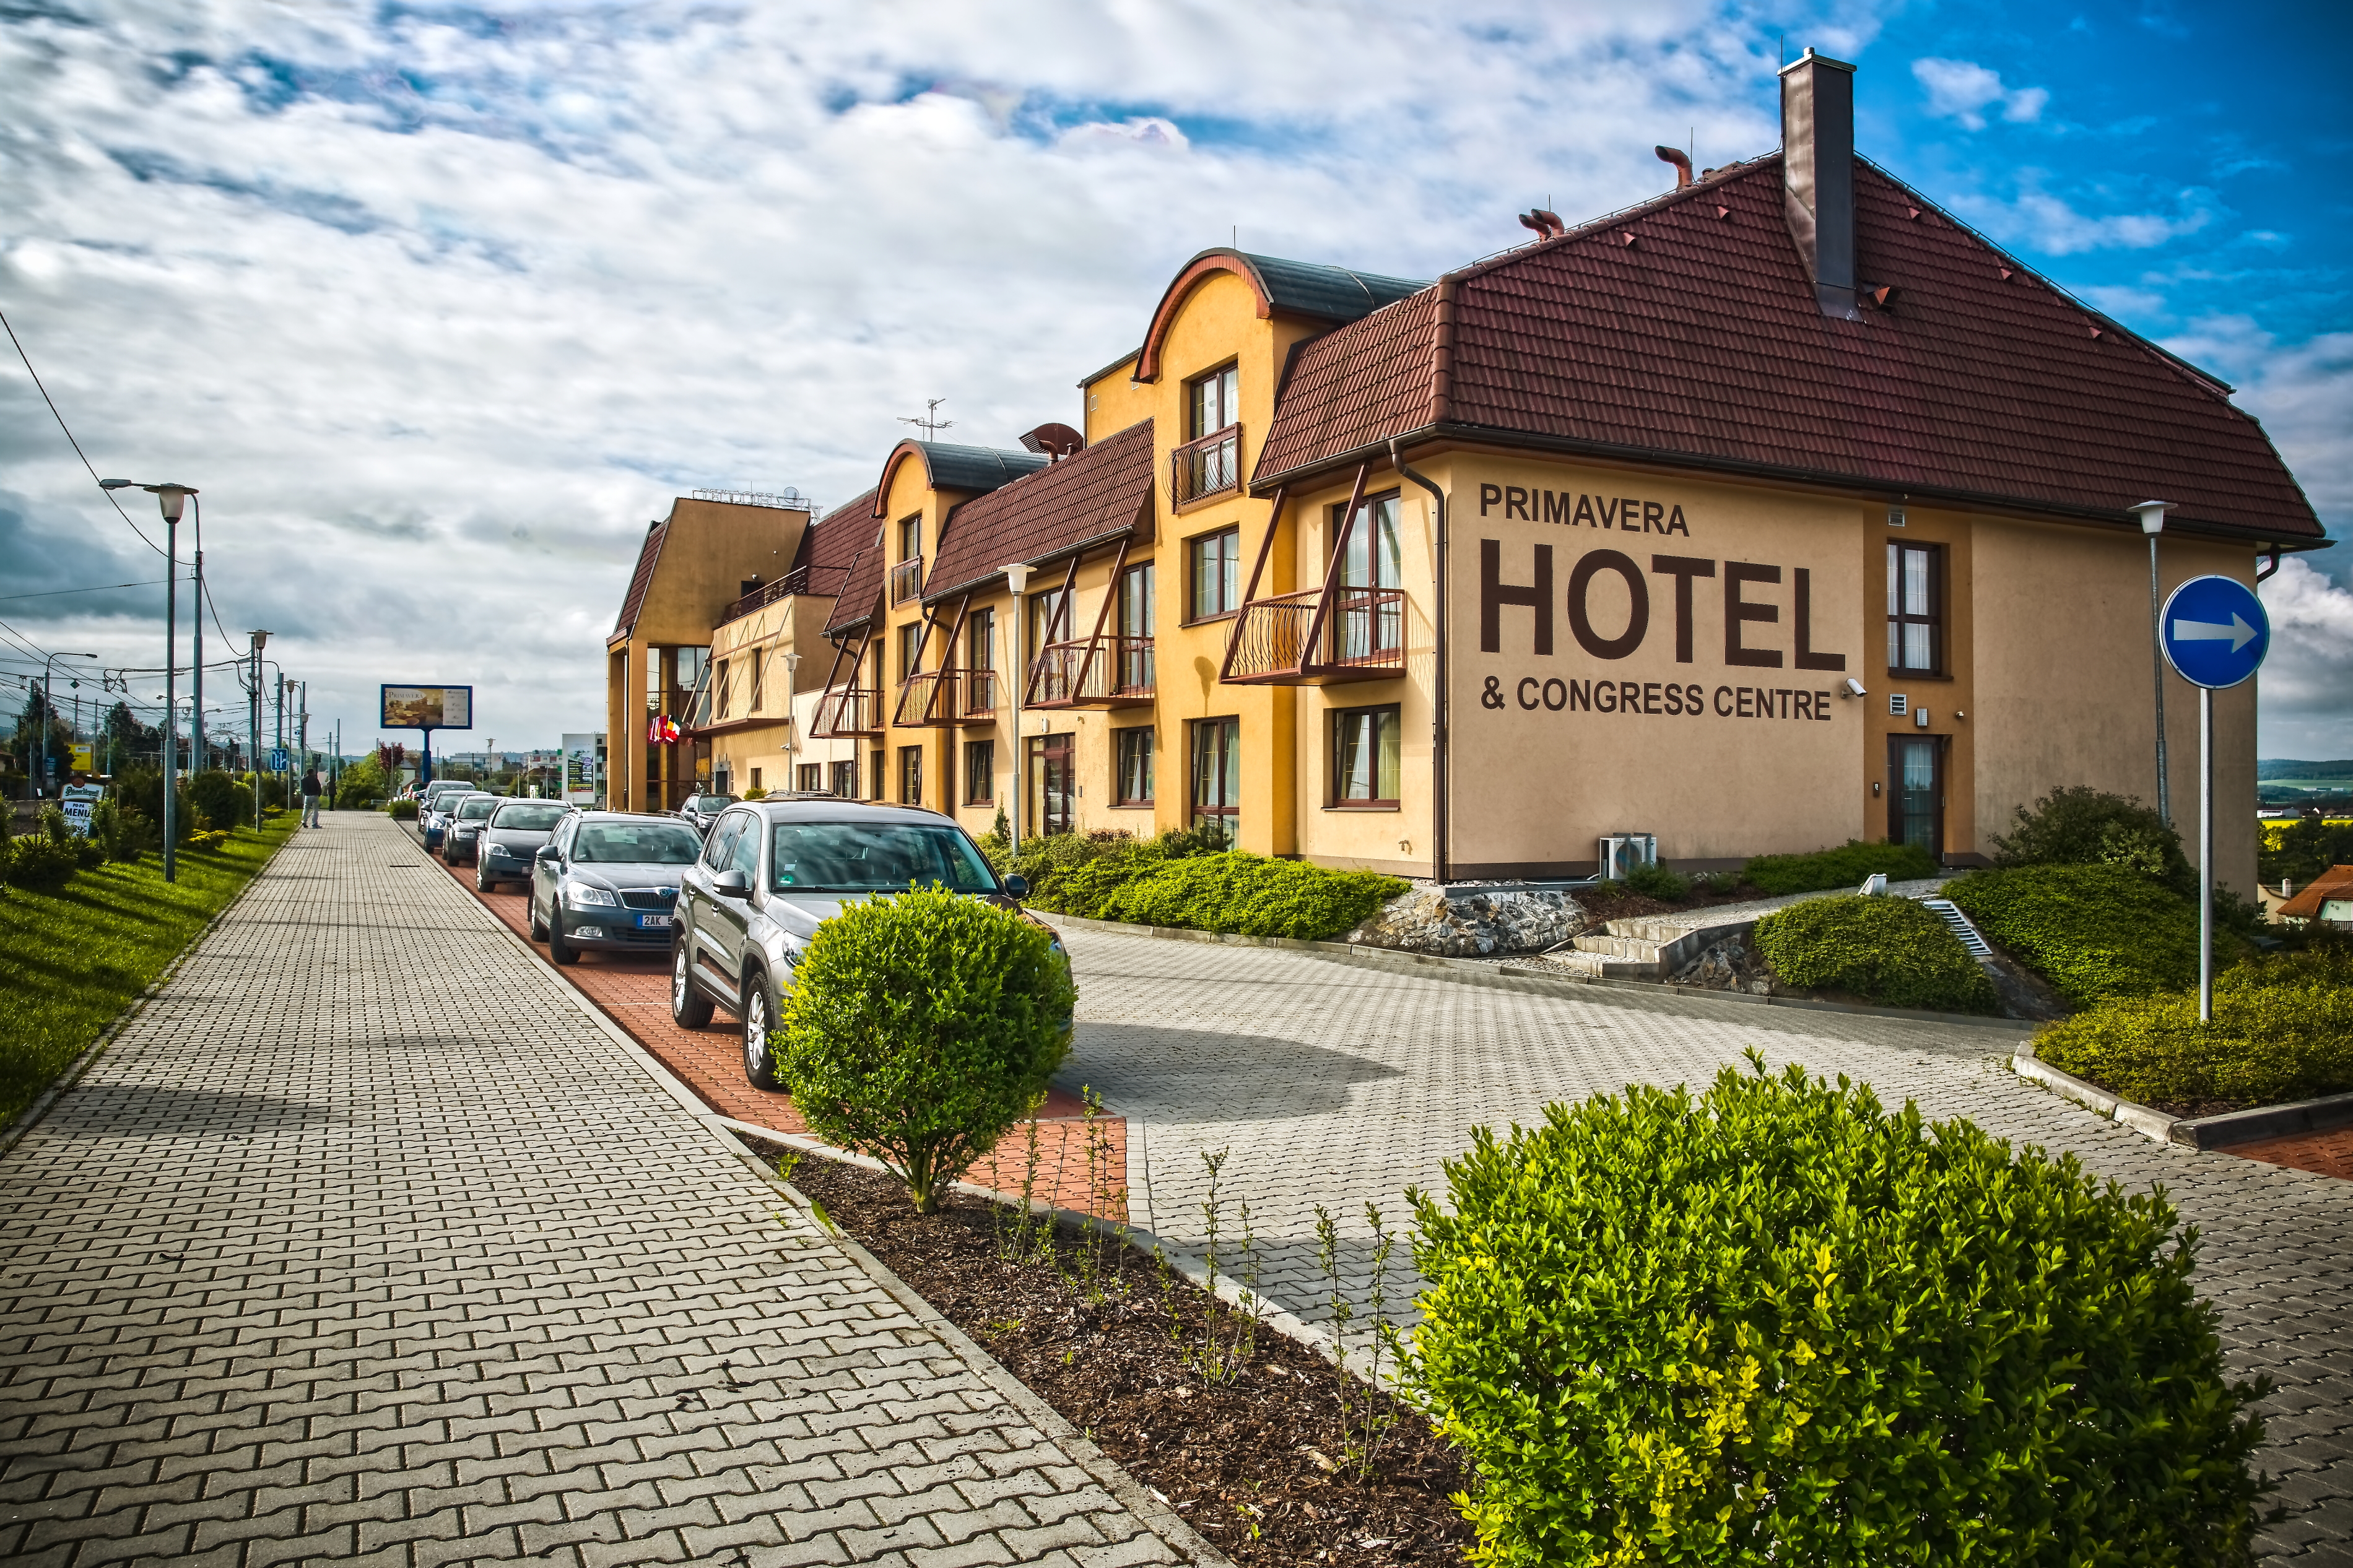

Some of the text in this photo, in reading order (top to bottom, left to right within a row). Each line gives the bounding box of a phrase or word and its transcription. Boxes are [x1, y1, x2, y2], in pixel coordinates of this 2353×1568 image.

[1481, 483, 1690, 537] PRIMAVERA
[1481, 539, 1845, 671] HOTEL
[1481, 676, 1830, 721] & CONGRESS CENTRE
[645, 916, 661, 925] 2AK
